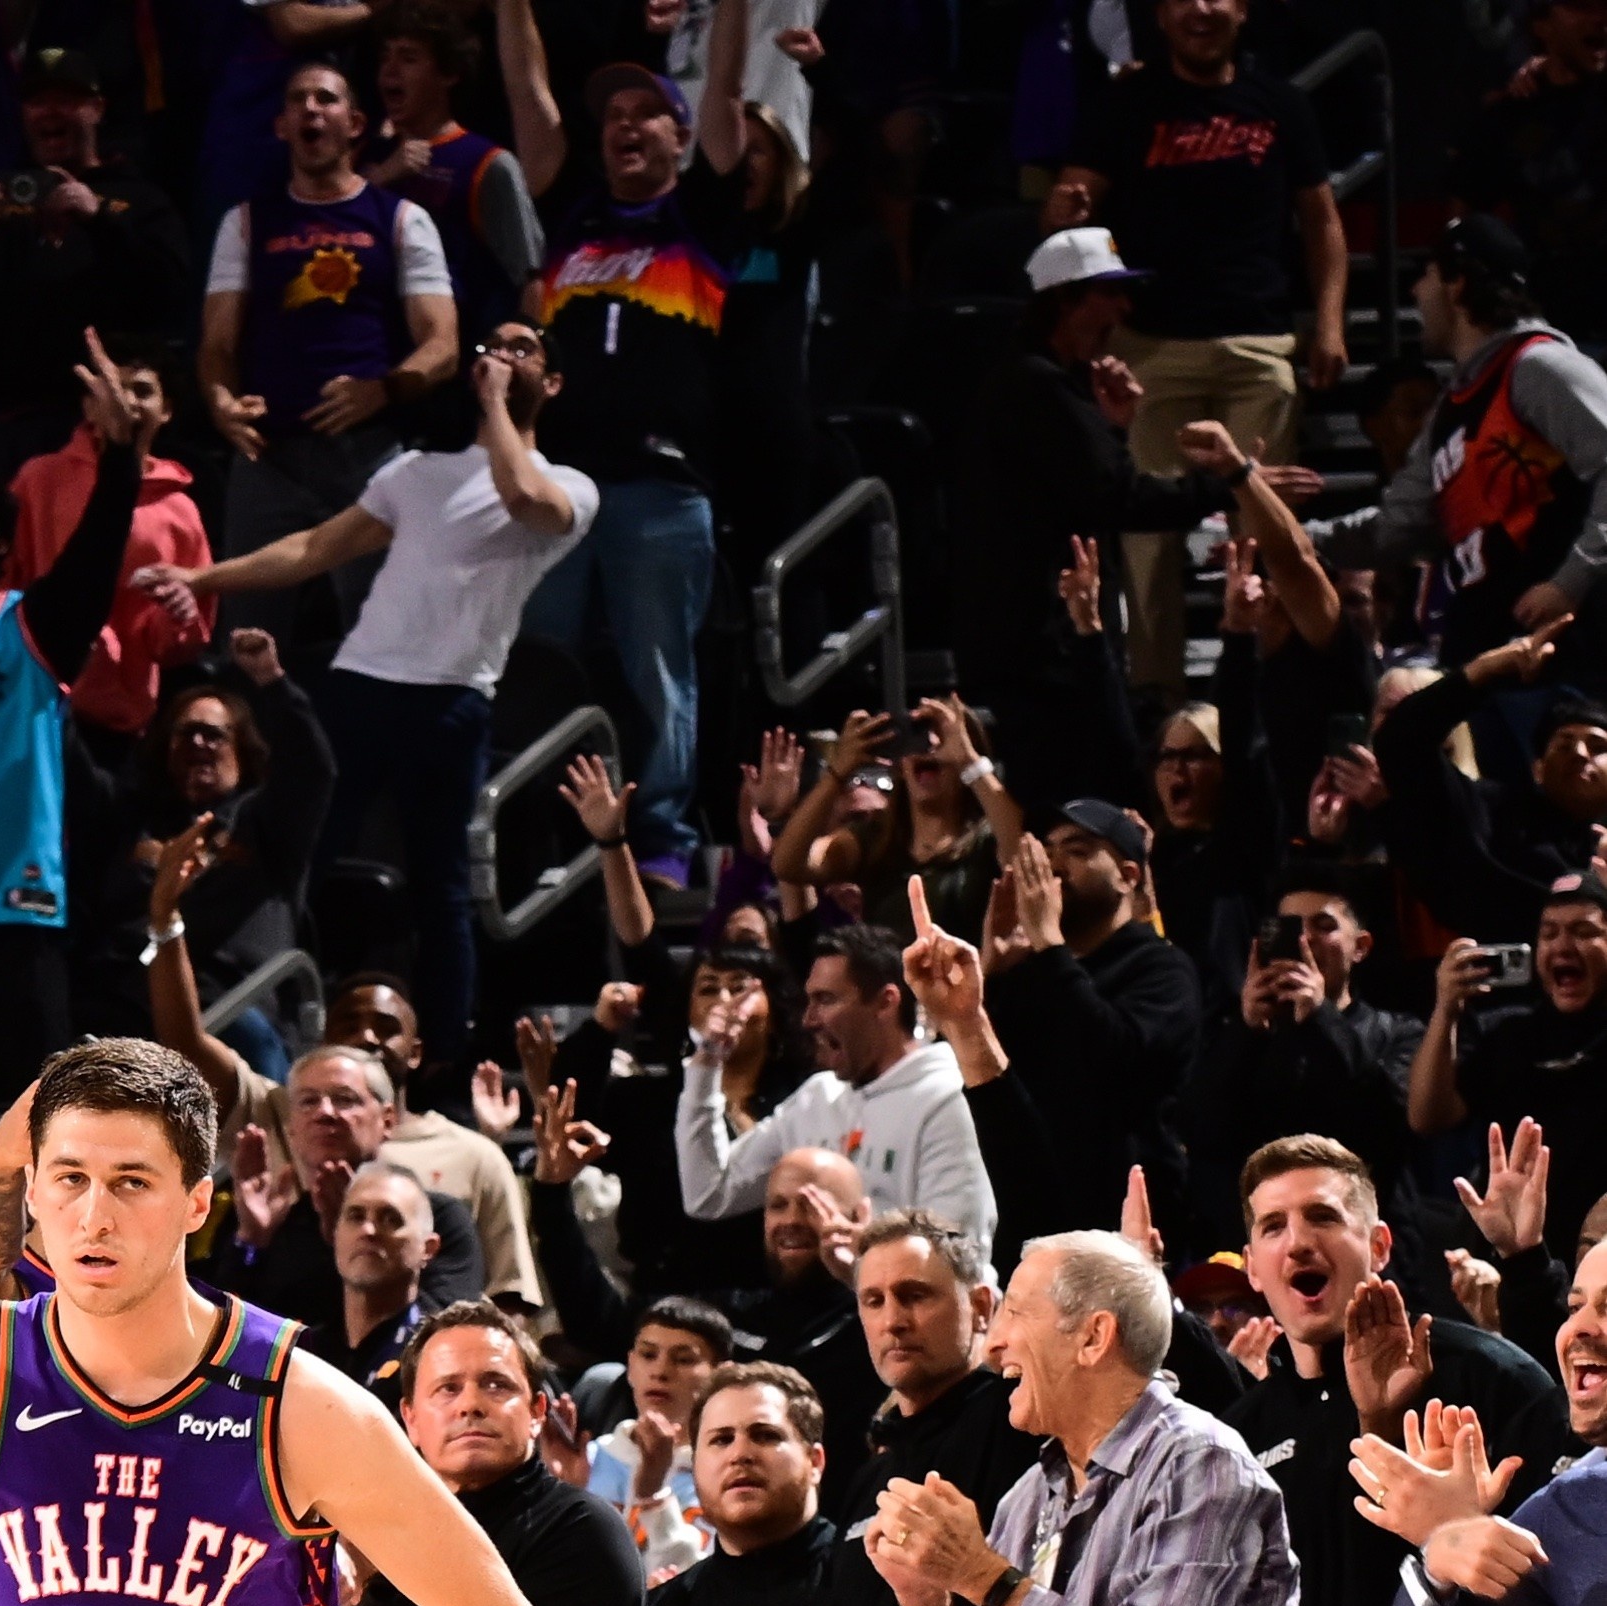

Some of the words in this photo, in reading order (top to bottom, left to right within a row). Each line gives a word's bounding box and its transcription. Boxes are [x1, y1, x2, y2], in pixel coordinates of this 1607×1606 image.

[604, 302, 621, 355] 1
[178, 1414, 252, 1441] PayPal
[95, 1453, 162, 1499] THE
